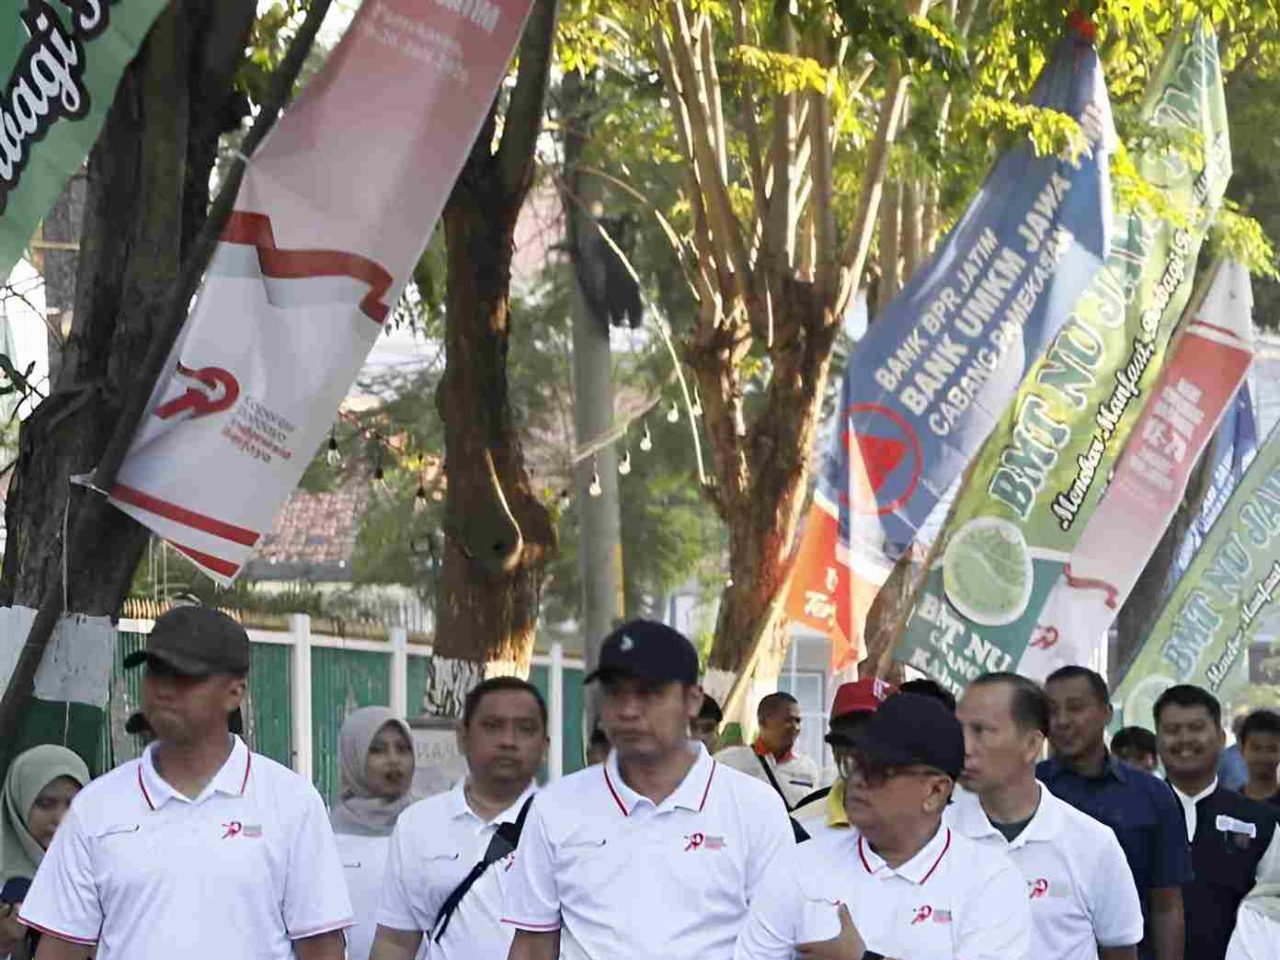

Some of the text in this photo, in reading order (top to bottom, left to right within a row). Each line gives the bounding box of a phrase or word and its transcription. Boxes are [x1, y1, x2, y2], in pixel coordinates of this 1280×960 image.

[874, 227, 1000, 391] BANK BPR JATIM
[900, 172, 1073, 416] BANK UMKM JAWA
[928, 346, 999, 436] CABANG
[989, 394, 1070, 522] BMT
[1037, 313, 1104, 412] NU
[1162, 588, 1223, 681] BMT
